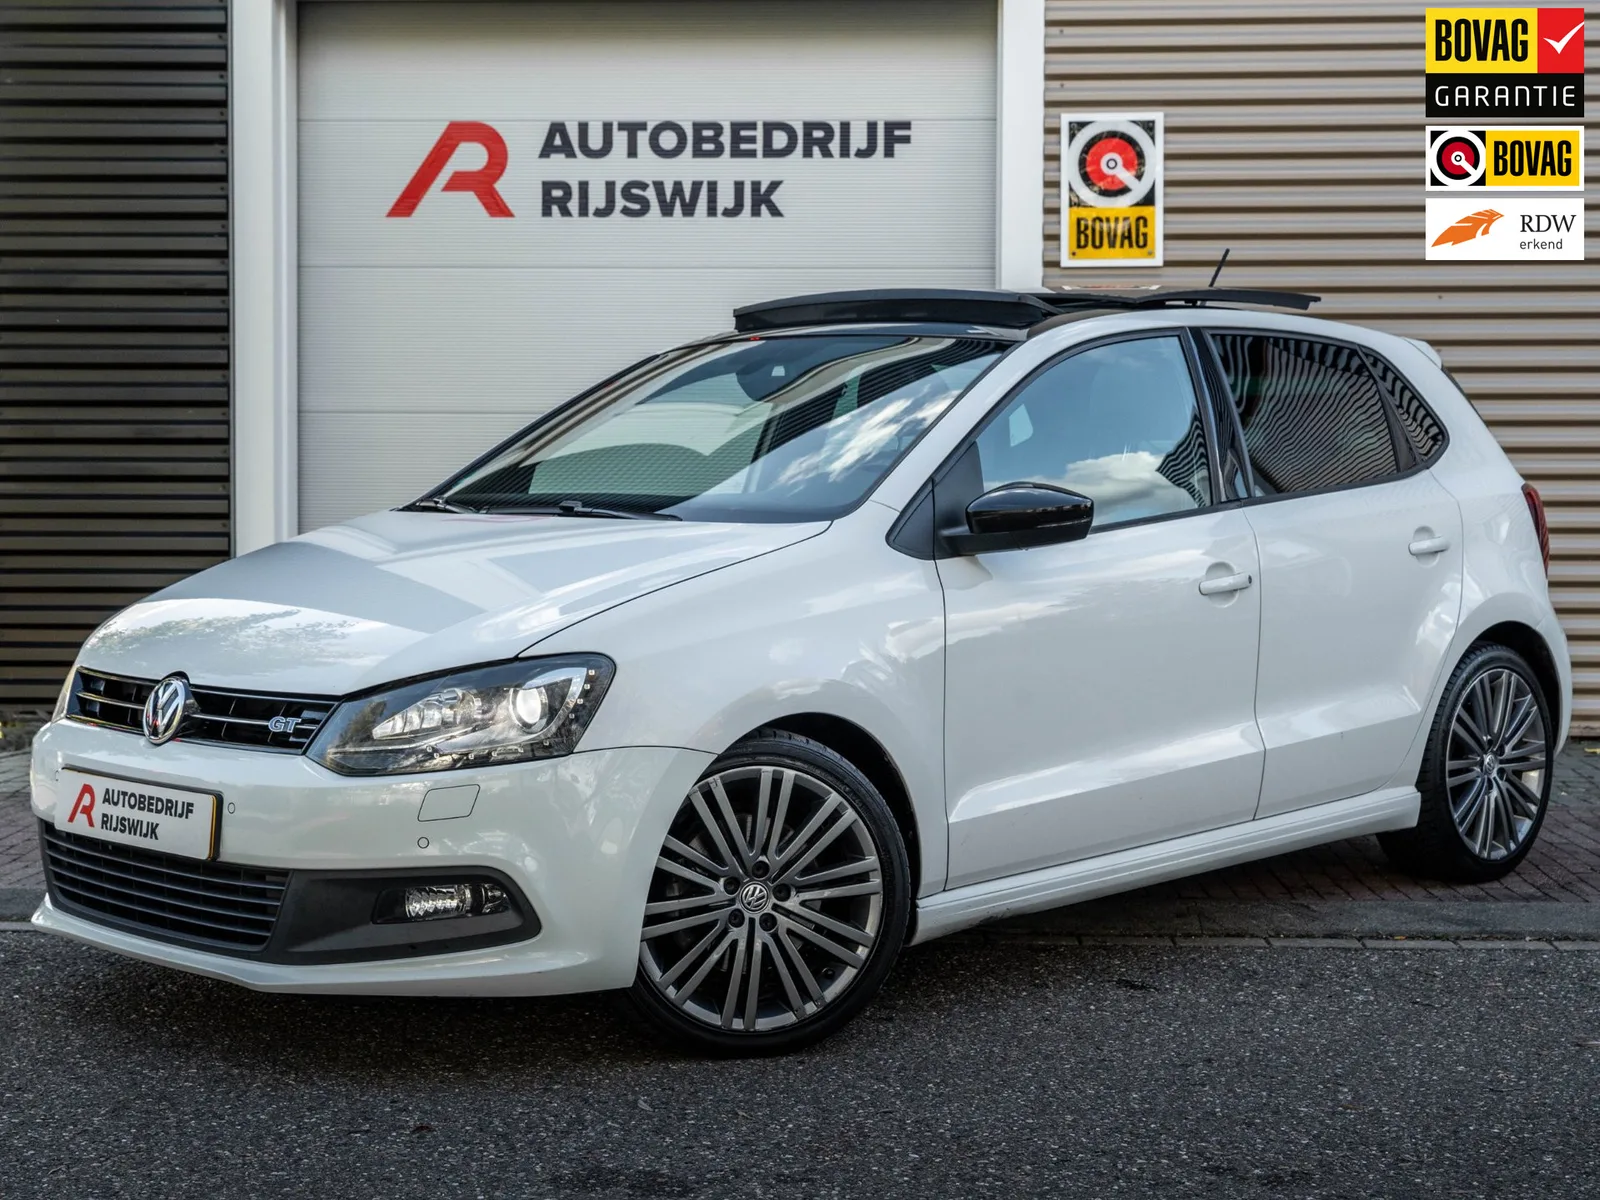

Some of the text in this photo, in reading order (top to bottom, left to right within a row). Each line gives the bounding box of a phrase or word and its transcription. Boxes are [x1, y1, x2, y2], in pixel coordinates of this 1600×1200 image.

[538, 120, 912, 159] AUTOBEDRIJF
[540, 180, 785, 218] RIJSWIJK
[1076, 216, 1148, 249] BOVAG
[268, 715, 302, 733] GT
[102, 787, 195, 820] AUTOBEDRIJF
[100, 813, 160, 840] RIJSWIJK
